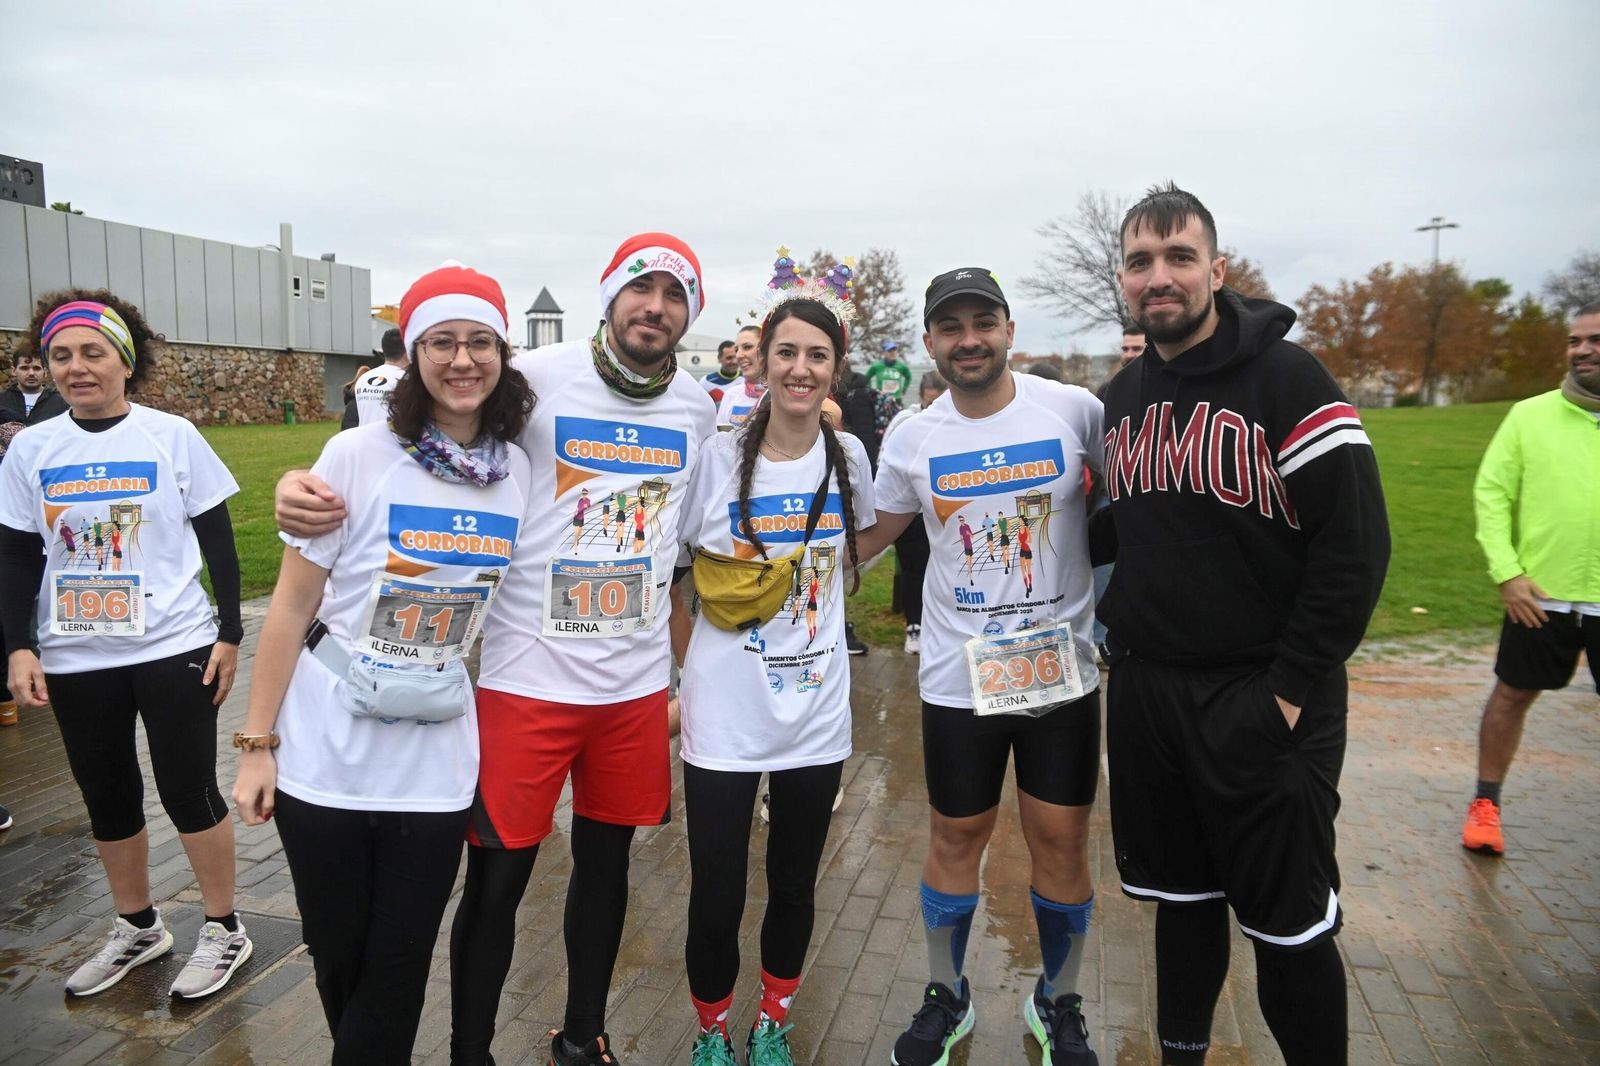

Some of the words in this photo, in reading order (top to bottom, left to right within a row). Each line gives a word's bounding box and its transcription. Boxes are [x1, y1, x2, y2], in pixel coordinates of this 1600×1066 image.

[615, 427, 639, 443] 12
[564, 439, 682, 468] CORDOBARIA
[981, 452, 1006, 467] 12
[85, 466, 107, 478] 12
[936, 460, 1059, 491] CORDOBARIA
[47, 477, 151, 498] CORDOBARIA
[782, 498, 805, 512] 12
[452, 515, 478, 532] 12
[560, 563, 647, 574] CORDOBARIA
[389, 587, 482, 600] CORDOBARIA
[568, 580, 628, 617] 10
[954, 587, 985, 605] 5km
[58, 590, 130, 620] 196
[981, 604, 1015, 613] ALIMENTOS
[1016, 600, 1046, 608] CÓRDOBA
[988, 610, 1018, 618] DICIEMBRE
[394, 603, 454, 644] 11
[798, 650, 826, 660] CÓRDOBA
[978, 650, 1062, 696] 296
